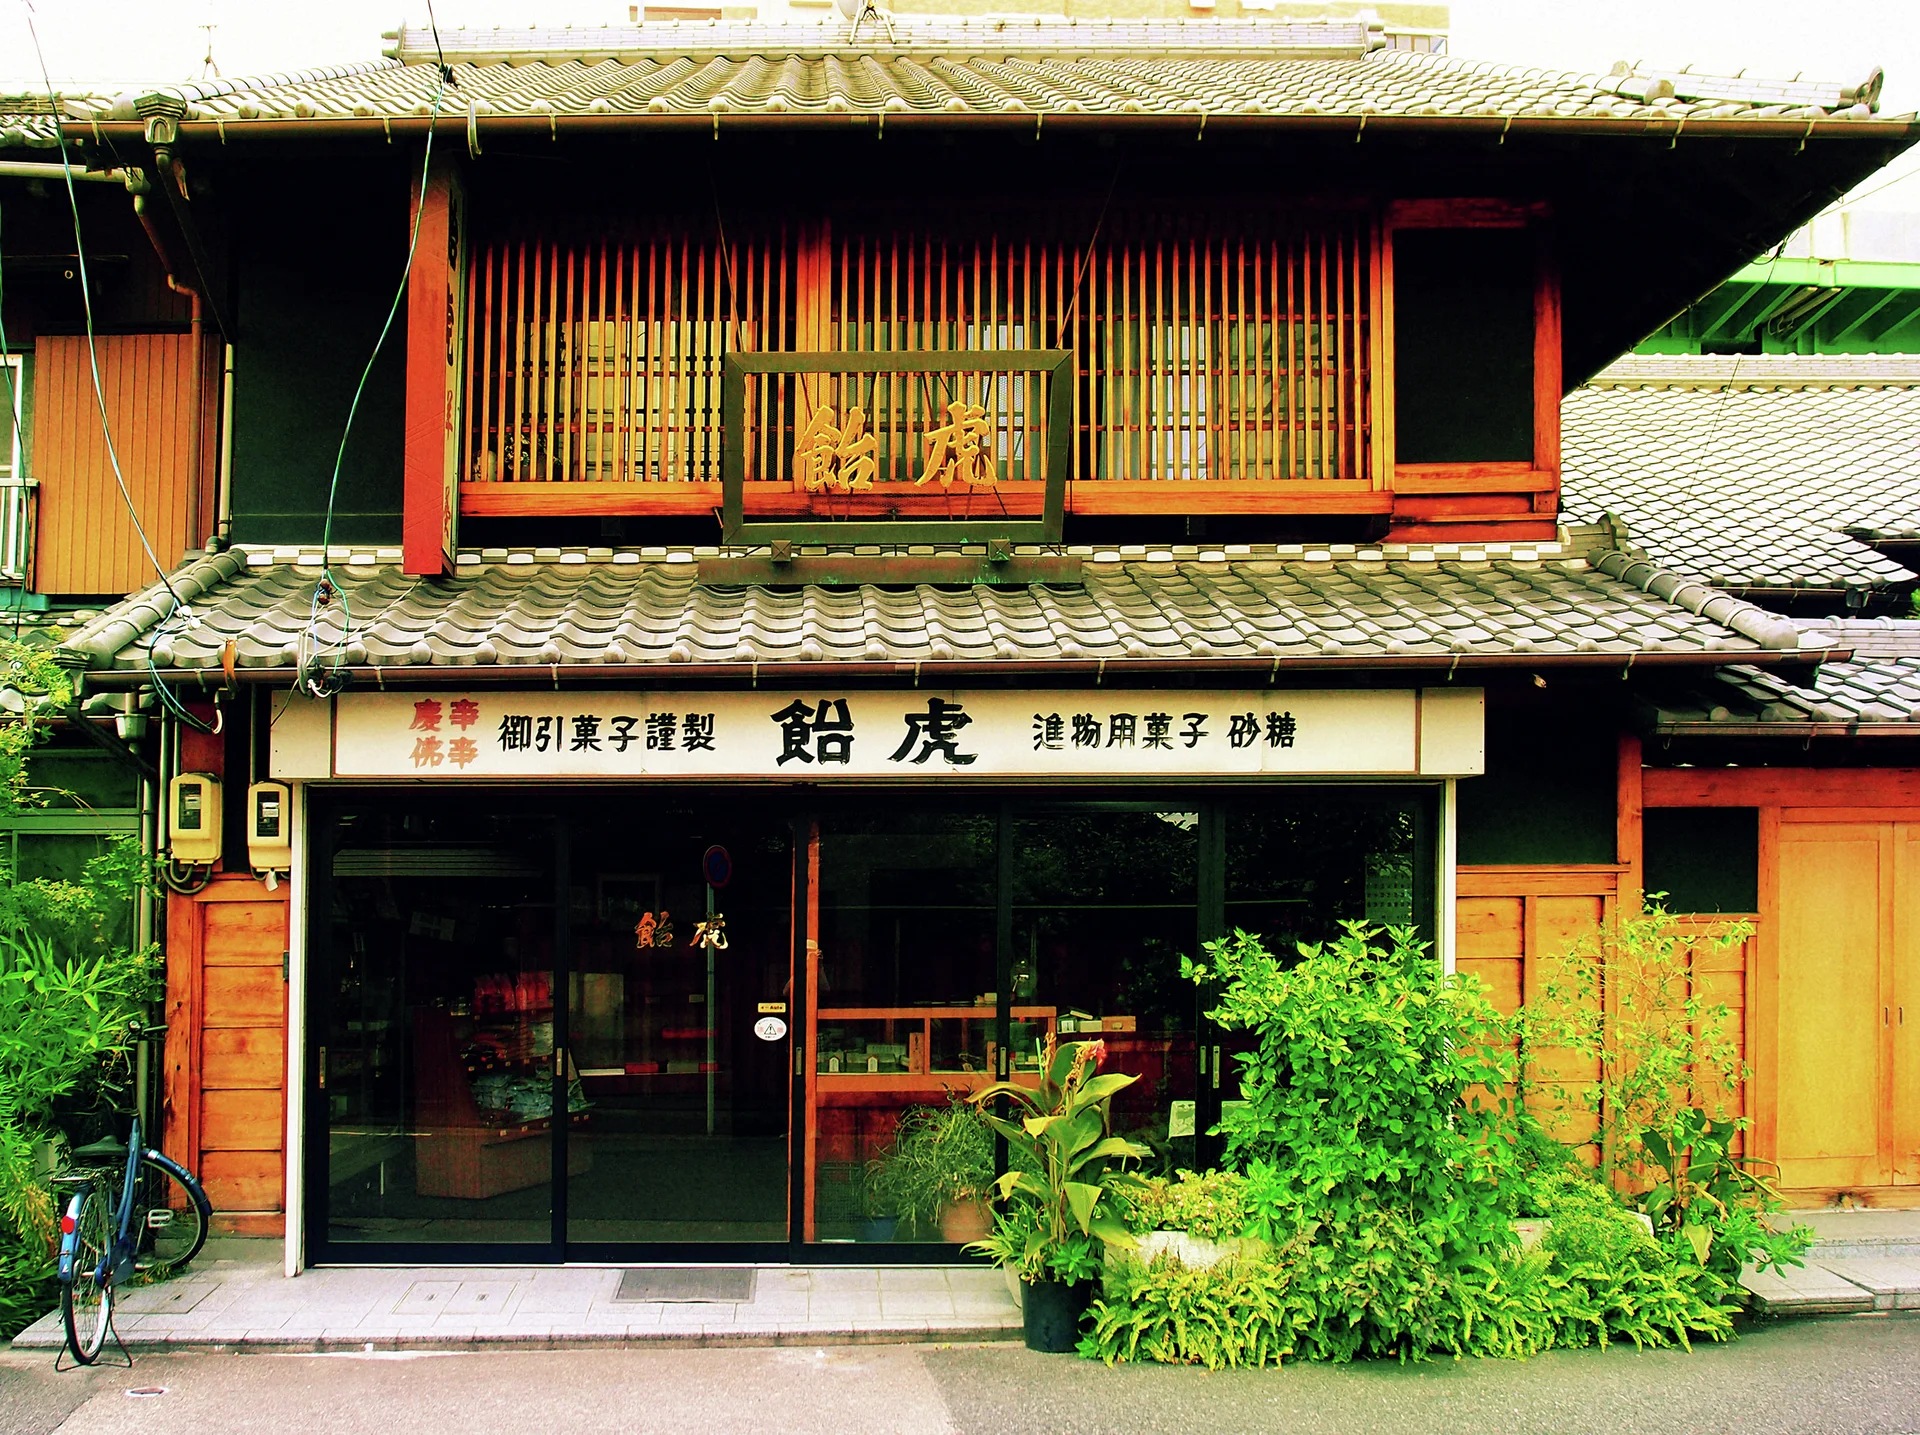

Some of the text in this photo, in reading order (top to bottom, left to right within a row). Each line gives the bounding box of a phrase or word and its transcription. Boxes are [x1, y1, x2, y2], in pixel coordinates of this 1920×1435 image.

[497, 712, 717, 753] 御引菓子謹製
[770, 698, 978, 767] 飴虎
[1032, 711, 1297, 751] 進物用菓子 砂糖
